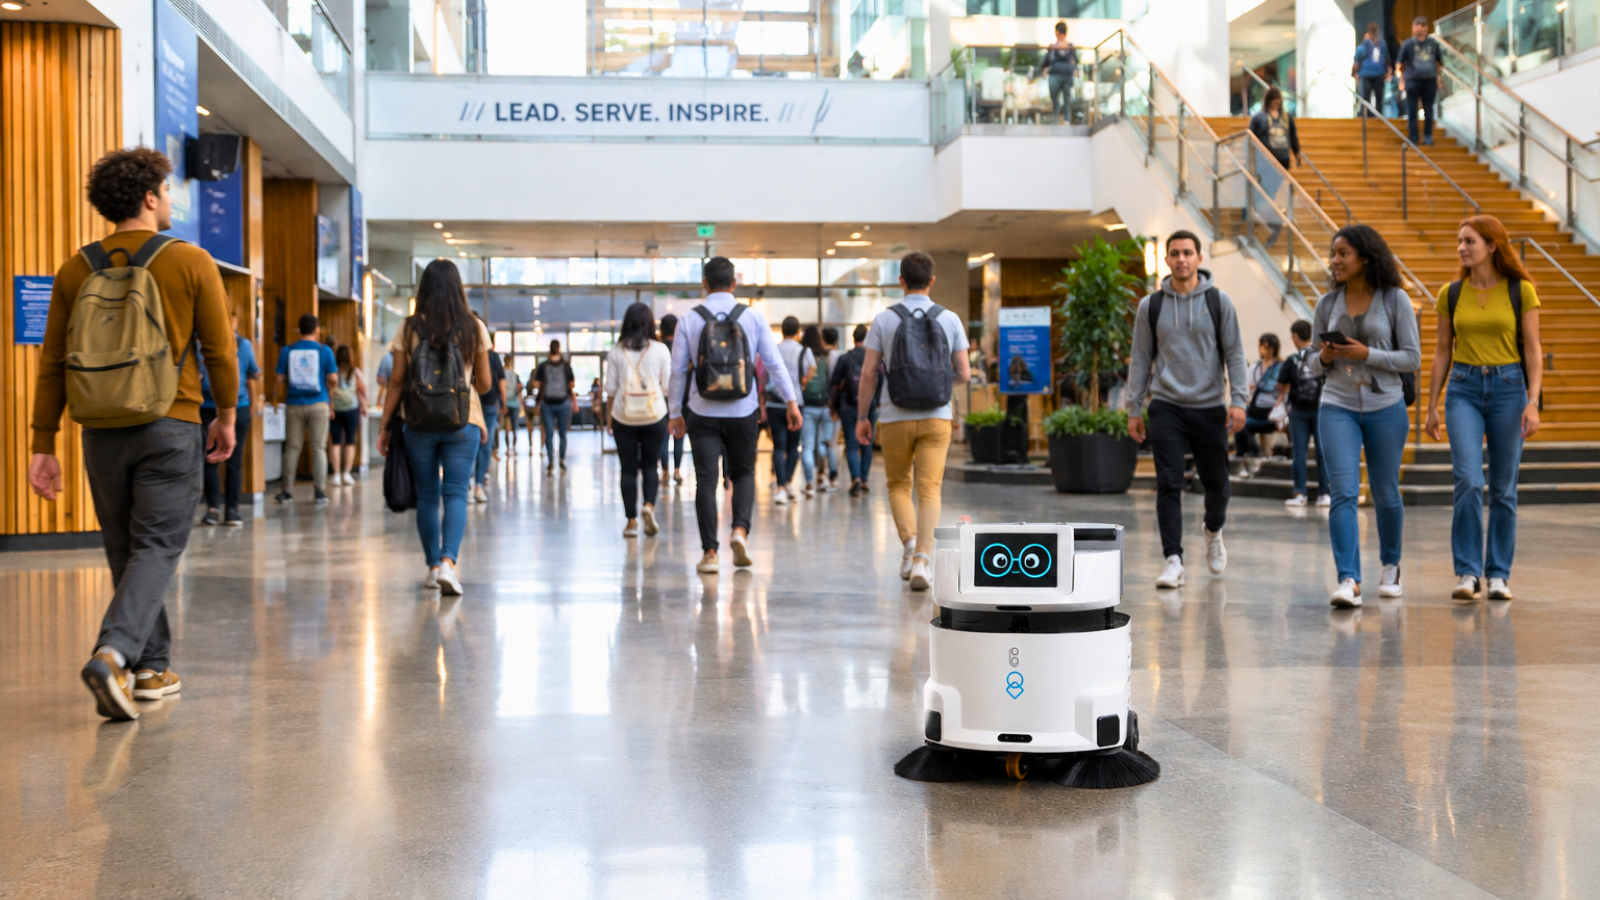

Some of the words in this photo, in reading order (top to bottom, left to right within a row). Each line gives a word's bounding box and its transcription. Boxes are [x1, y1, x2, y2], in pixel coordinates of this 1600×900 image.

[495, 102, 566, 122] LEAD.
[575, 103, 660, 122] SERVE.
[669, 103, 769, 122] INSPIRE.
